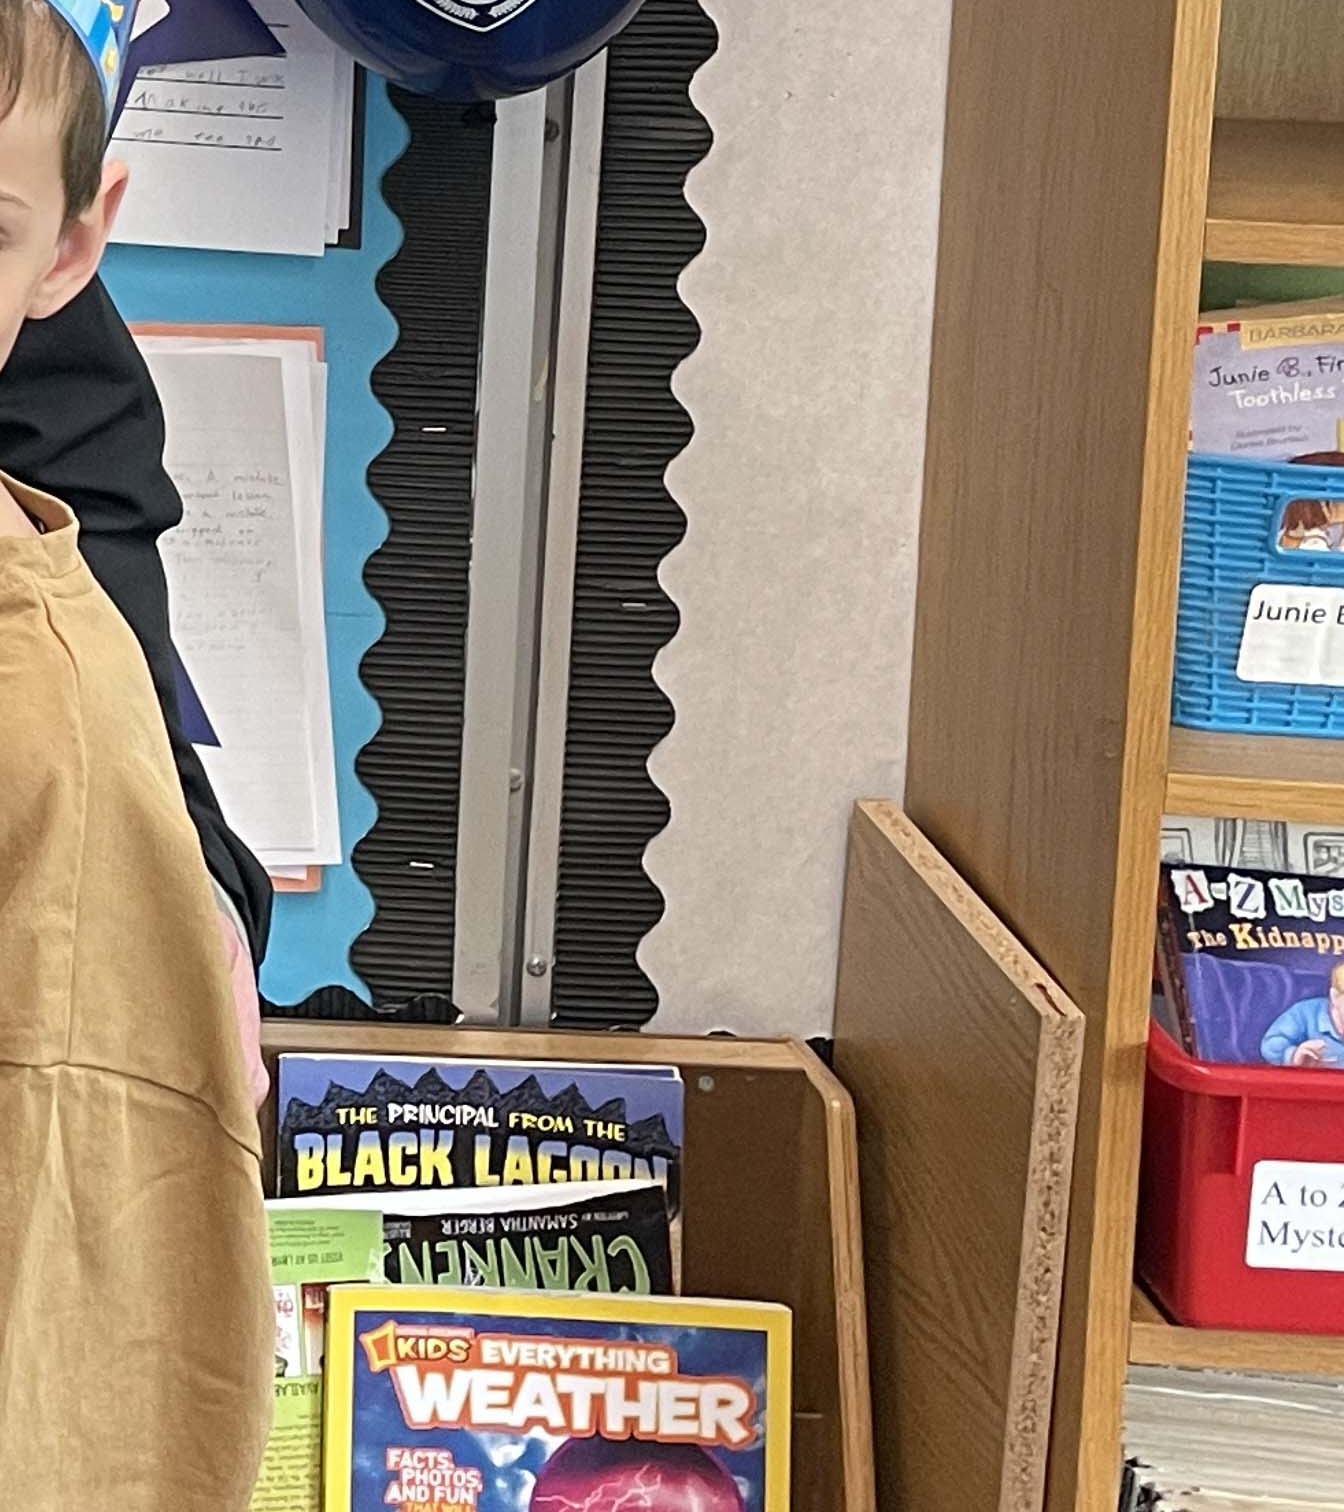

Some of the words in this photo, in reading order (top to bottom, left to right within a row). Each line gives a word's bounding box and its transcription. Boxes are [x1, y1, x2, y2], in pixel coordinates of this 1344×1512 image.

[1208, 365, 1271, 388] Junie
[1227, 381, 1336, 409] Toothless
[1253, 599, 1327, 625] Junie
[1186, 929, 1228, 950] The
[335, 1107, 379, 1127] THE
[386, 1102, 501, 1129] PRINCIPAL
[507, 1111, 575, 1134] FROM
[582, 1119, 626, 1143] THE
[293, 1128, 456, 1193] BLACK
[1260, 1180, 1287, 1206] A
[1300, 1184, 1328, 1208] to
[440, 1218, 496, 1236] BERGER
[498, 1211, 580, 1233] SAMANTHA
[395, 1336, 472, 1363] KIDS
[480, 1337, 673, 1376] EVERYTHING
[396, 1363, 754, 1443] WEATHER
[385, 1485, 430, 1502] AND
[433, 1487, 476, 1504] FUN
